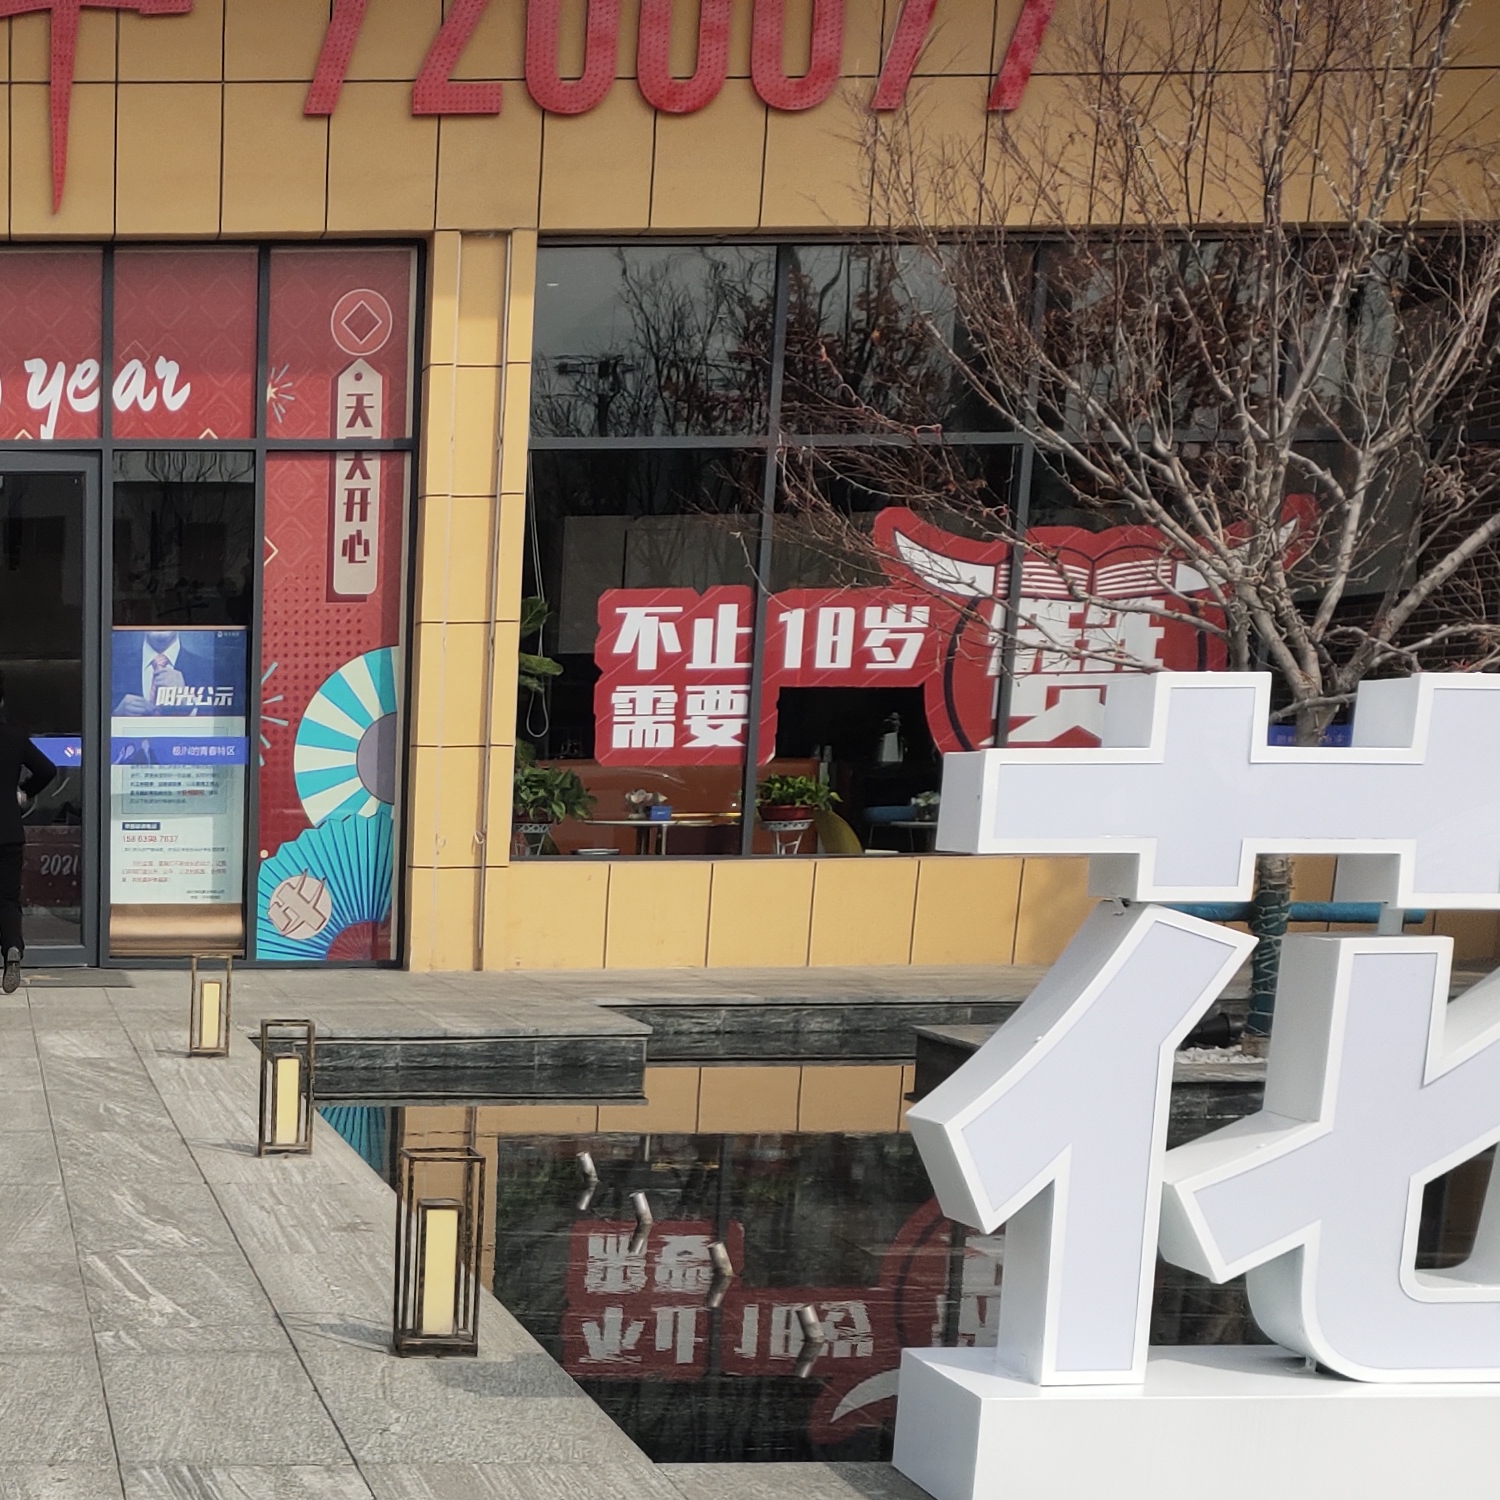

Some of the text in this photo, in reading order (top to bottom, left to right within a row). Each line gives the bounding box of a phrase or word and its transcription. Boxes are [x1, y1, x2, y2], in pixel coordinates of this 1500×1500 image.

[24, 356, 191, 440] year
[341, 392, 373, 564] 天天开心
[156, 686, 234, 707] 阳光公示
[610, 685, 749, 749] 需要
